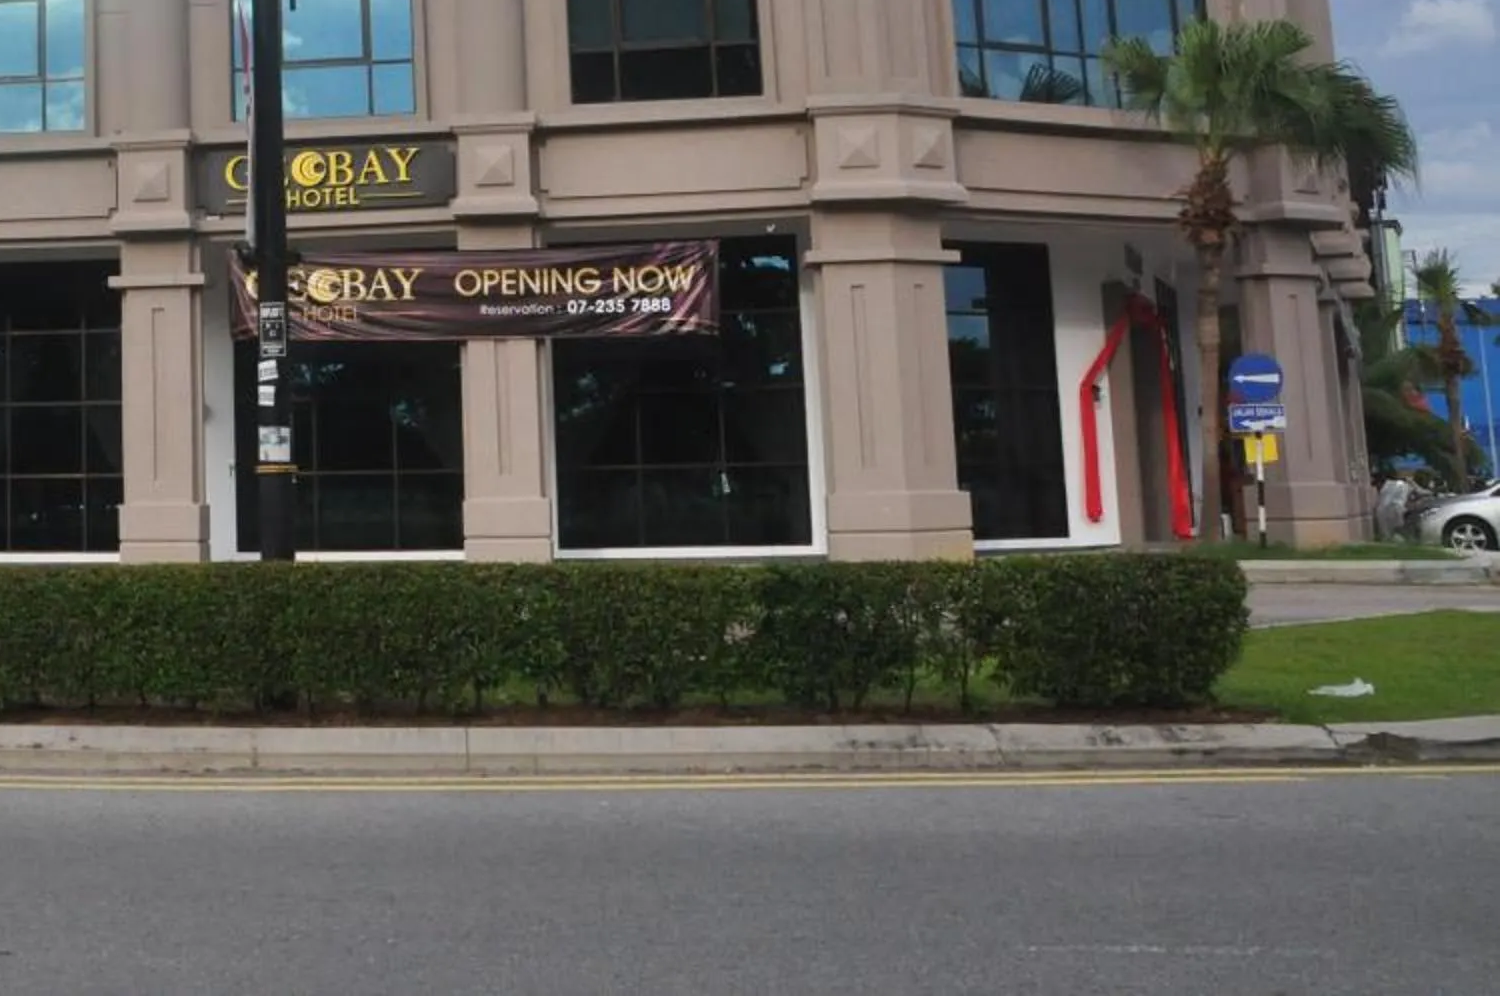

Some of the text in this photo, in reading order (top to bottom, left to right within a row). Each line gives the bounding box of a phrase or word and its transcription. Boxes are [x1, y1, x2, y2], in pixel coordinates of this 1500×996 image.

[224, 147, 420, 191] GOBAY
[286, 188, 360, 208] HOTEL
[454, 265, 697, 297] OPENING NOW
[303, 305, 358, 322] HOTEL
[479, 303, 553, 317] Reservation
[566, 297, 626, 315] 07-235
[631, 296, 672, 313] 7888
